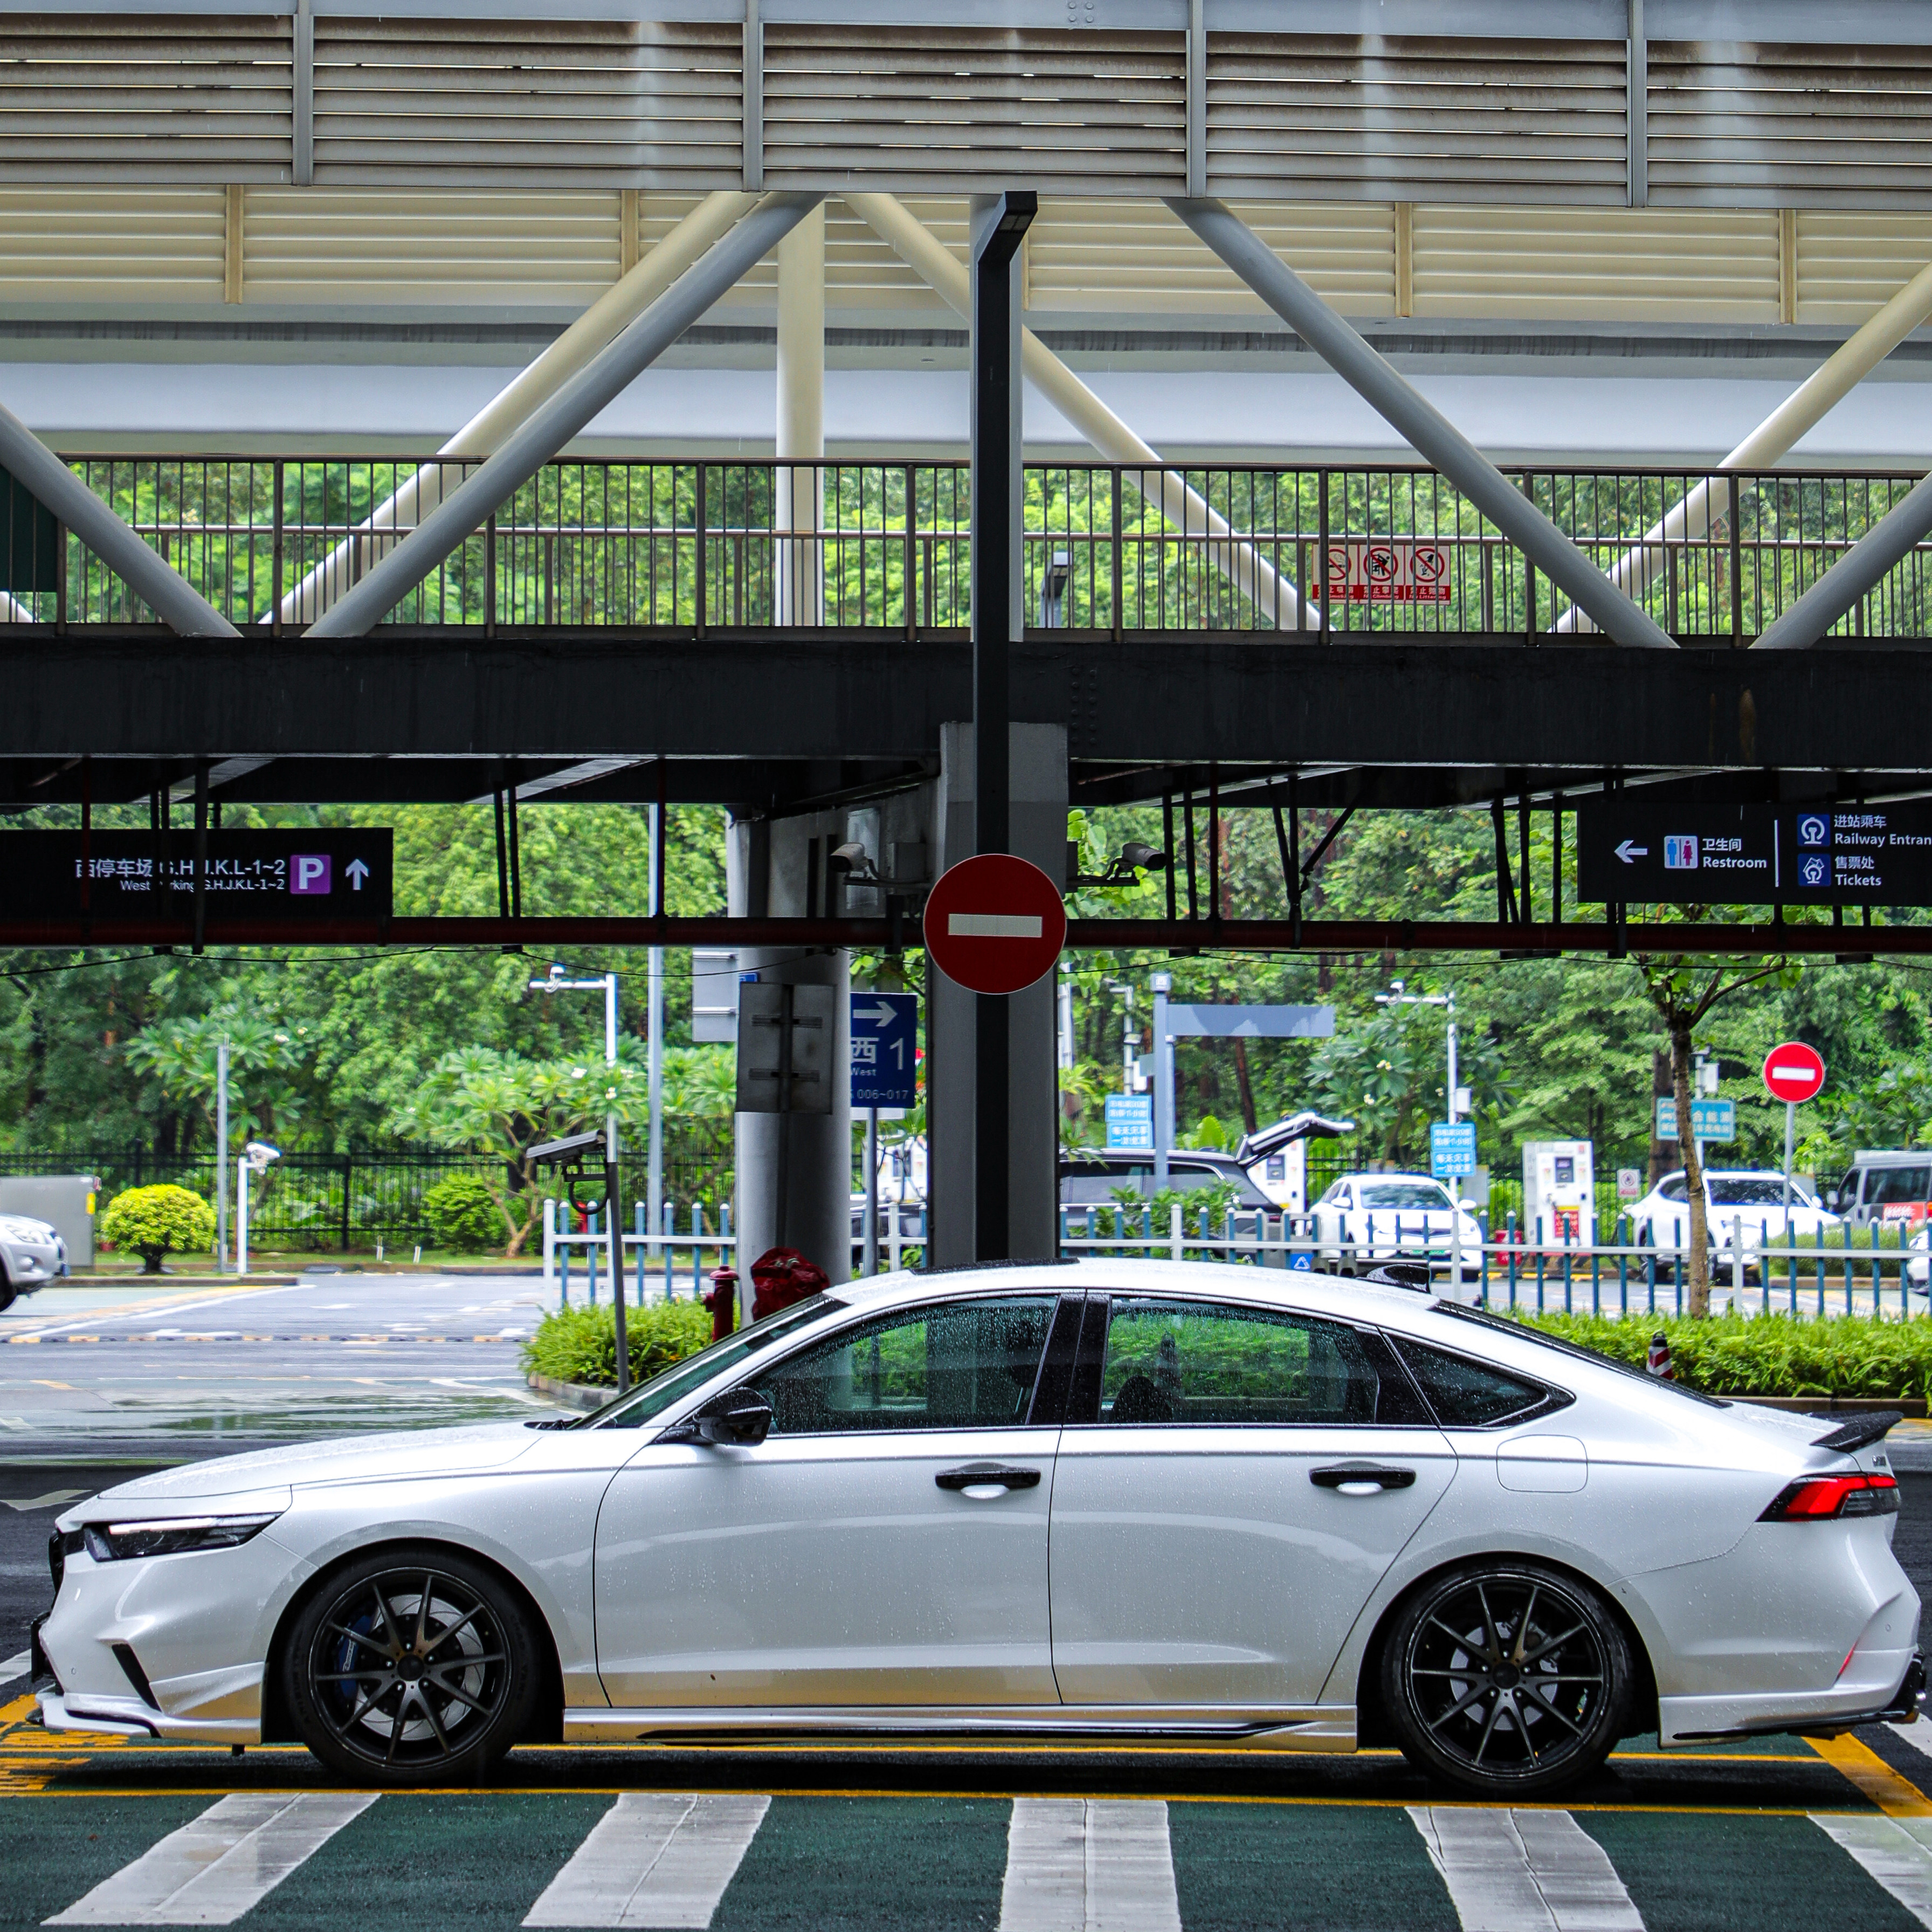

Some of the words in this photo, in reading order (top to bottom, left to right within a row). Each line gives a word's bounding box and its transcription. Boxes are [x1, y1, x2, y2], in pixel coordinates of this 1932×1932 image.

[1834, 815, 1887, 829] 进站乘车
[1702, 838, 1742, 852] 卫生间
[1835, 833, 1886, 848] Railway
[1889, 833, 1932, 845] Entran
[1702, 856, 1767, 868] Restroom
[1834, 856, 1875, 870] 售票处
[120, 880, 151, 891] West
[1835, 874, 1882, 886] Tickets
[851, 1037, 880, 1064] 西
[889, 1037, 904, 1070] 1
[851, 1067, 877, 1076] West
